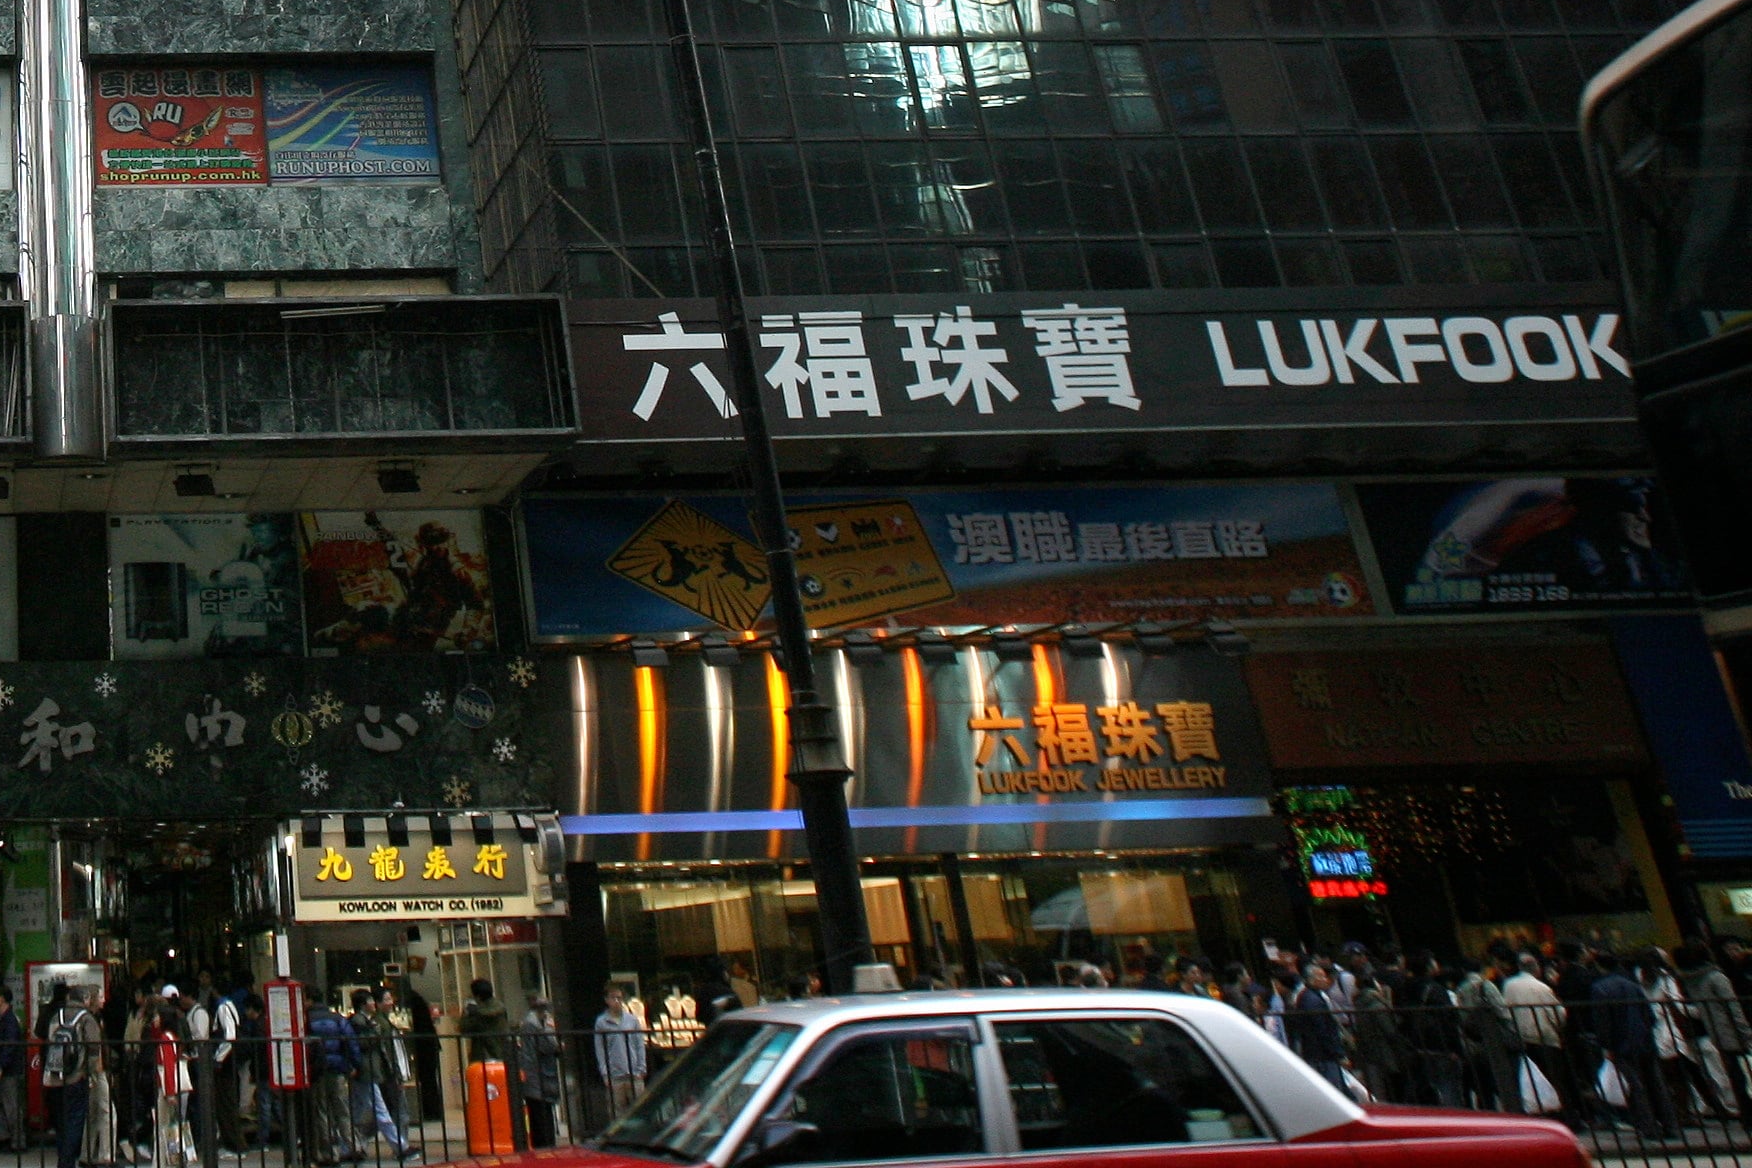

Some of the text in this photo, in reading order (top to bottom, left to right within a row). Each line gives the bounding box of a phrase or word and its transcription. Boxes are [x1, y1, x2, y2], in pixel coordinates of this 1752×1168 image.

[276, 159, 432, 175] RUNUPHOST.COM
[100, 170, 262, 183] shoprunup.com.hk
[622, 303, 1633, 422] 六福珠寶 LUKFOOK
[200, 588, 284, 602] GHOST
[200, 601, 284, 615] RECN
[969, 700, 1221, 767] 六福珠寶
[977, 766, 1227, 795] LUKFOOK JEWELLERY
[315, 844, 508, 882] 九龍表行
[338, 901, 397, 913] KOWLOON
[402, 900, 444, 912] WATCH
[448, 899, 469, 911] CO.
